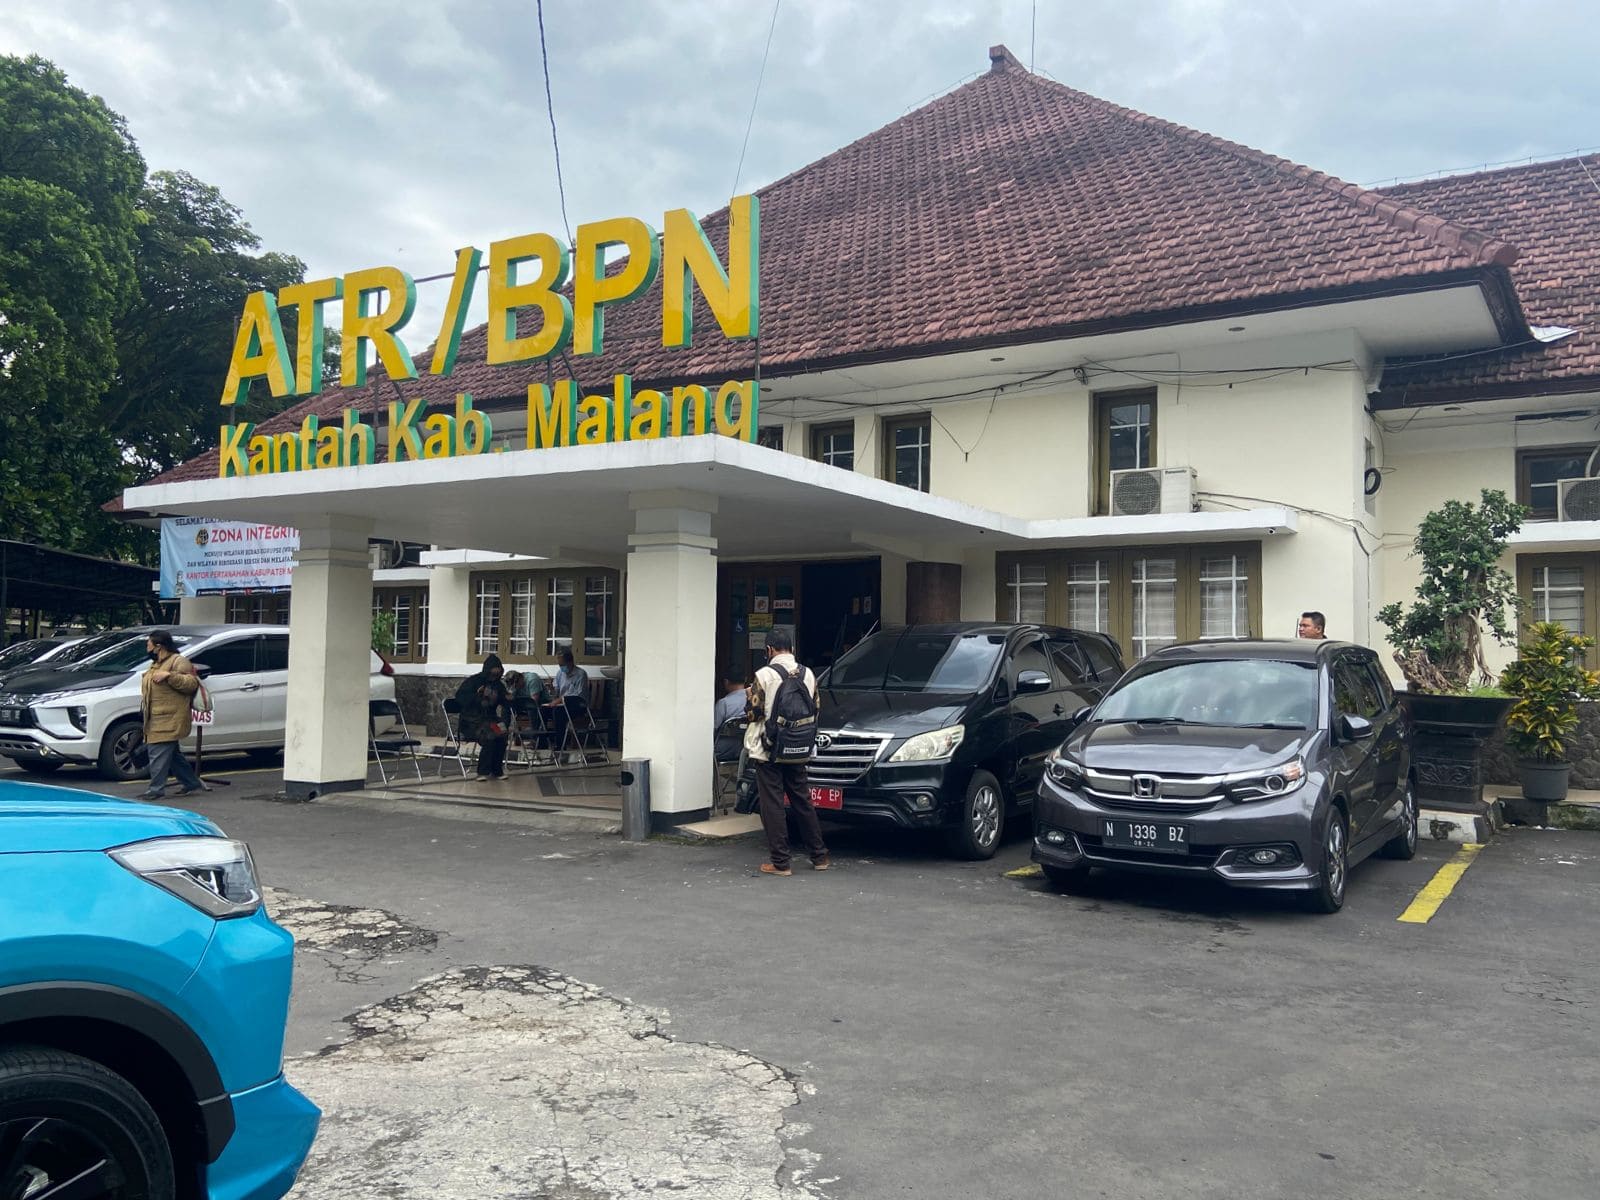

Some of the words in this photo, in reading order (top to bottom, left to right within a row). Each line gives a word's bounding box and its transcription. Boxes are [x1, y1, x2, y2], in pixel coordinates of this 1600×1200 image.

[220, 408, 375, 478] Kantah
[527, 374, 759, 450] Malang
[176, 517, 204, 526] SELAMAT
[212, 528, 243, 543] ZONA
[247, 526, 301, 541] INTEGRIT
[187, 571, 209, 580] KANTOR
[808, 788, 822, 801] 64
[829, 788, 840, 802] EP
[1106, 821, 1114, 837] N
[1129, 823, 1157, 840] 1336
[1169, 826, 1184, 842] BZ
